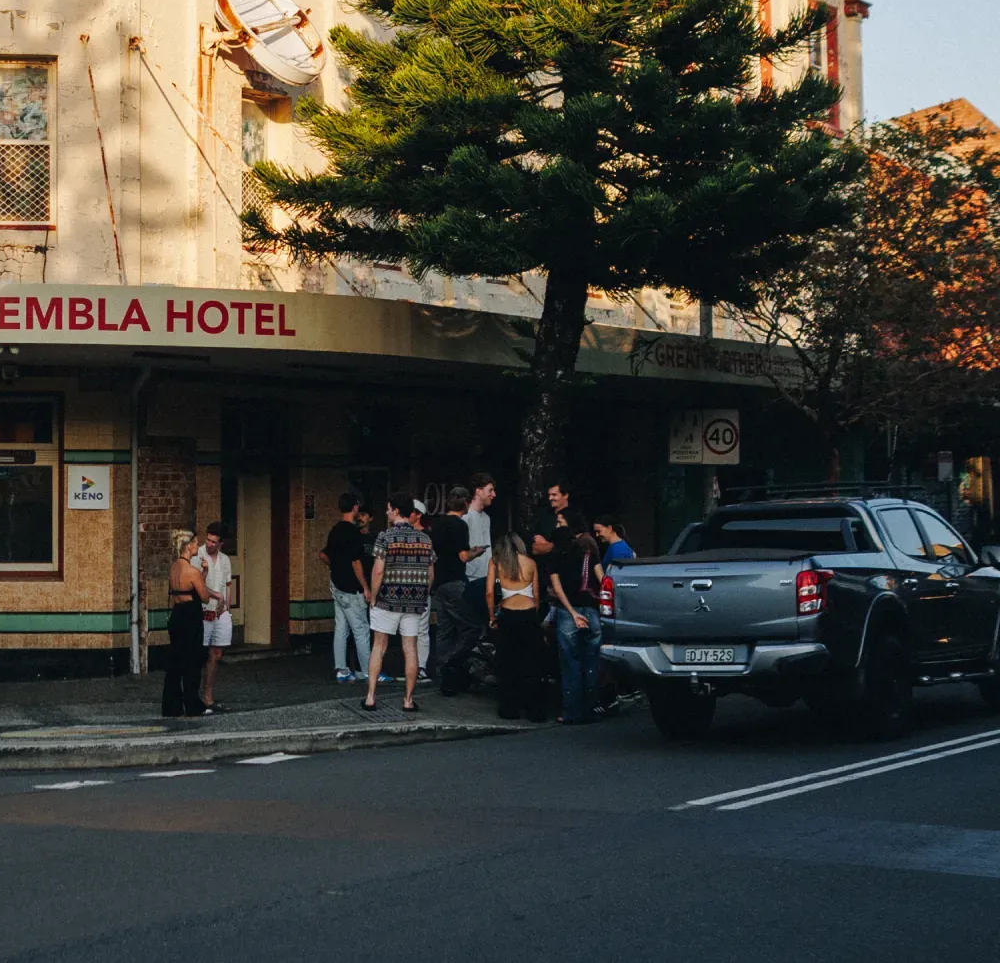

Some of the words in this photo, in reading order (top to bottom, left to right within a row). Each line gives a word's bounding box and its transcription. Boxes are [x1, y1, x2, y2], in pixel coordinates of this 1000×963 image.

[166, 299, 296, 336] HOTEL
[709, 428, 734, 445] 40
[74, 492, 104, 500] KENO
